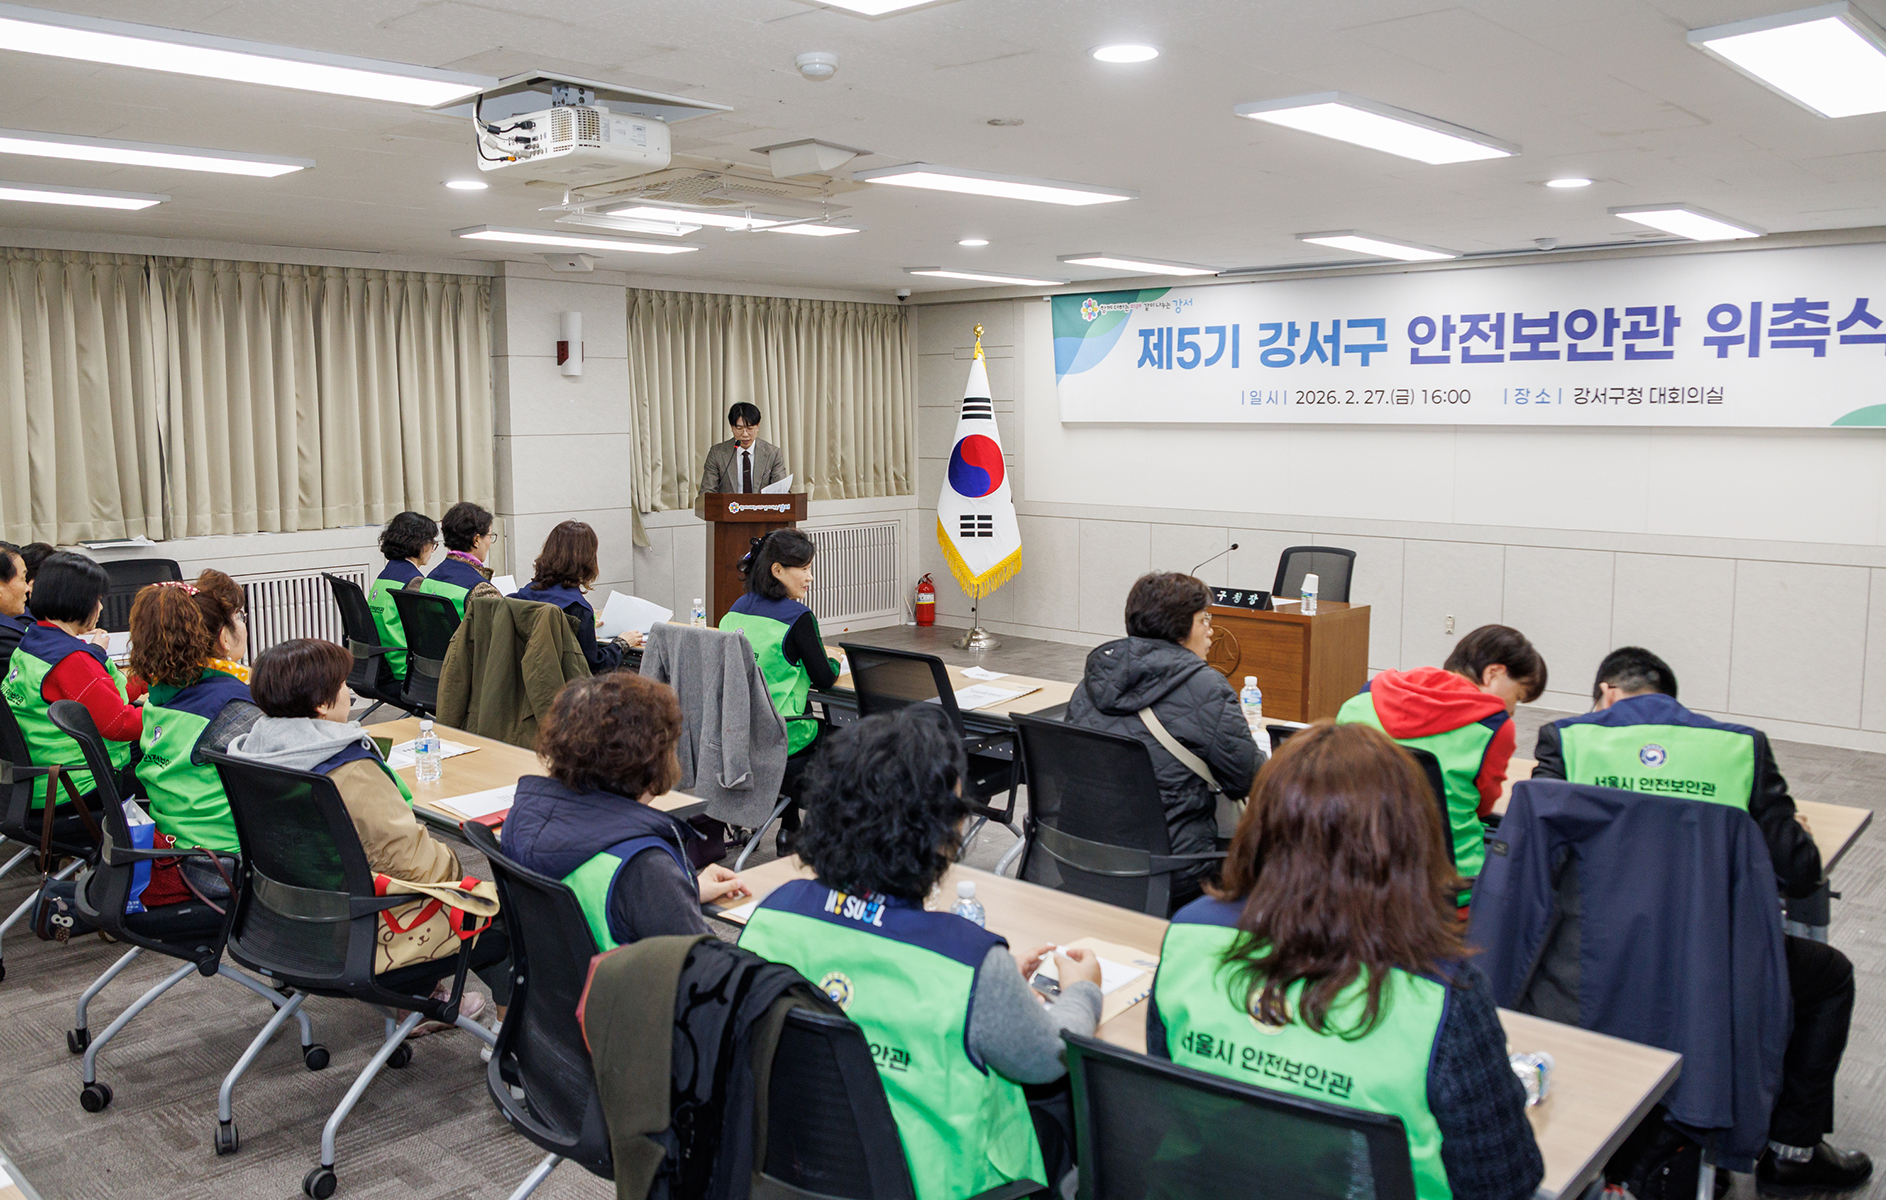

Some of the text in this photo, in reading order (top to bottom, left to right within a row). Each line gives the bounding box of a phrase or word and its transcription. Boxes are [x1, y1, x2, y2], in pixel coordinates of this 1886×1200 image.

[1172, 298, 1193, 313] 강서
[1137, 324, 1240, 370] 제5기
[1259, 318, 1388, 368] 강서구
[1407, 304, 1681, 365] 안전보안관
[1296, 390, 1340, 405] 2026.
[1345, 390, 1359, 405] 2.
[1364, 389, 1414, 405] 27.(금)
[1422, 389, 1471, 405] 16:00
[1574, 387, 1643, 405] 강서구청
[1650, 386, 1724, 405] 대회의실
[1639, 778, 1717, 797] 안전보안관
[1182, 1031, 1355, 1099] 서울시 안전보안관
